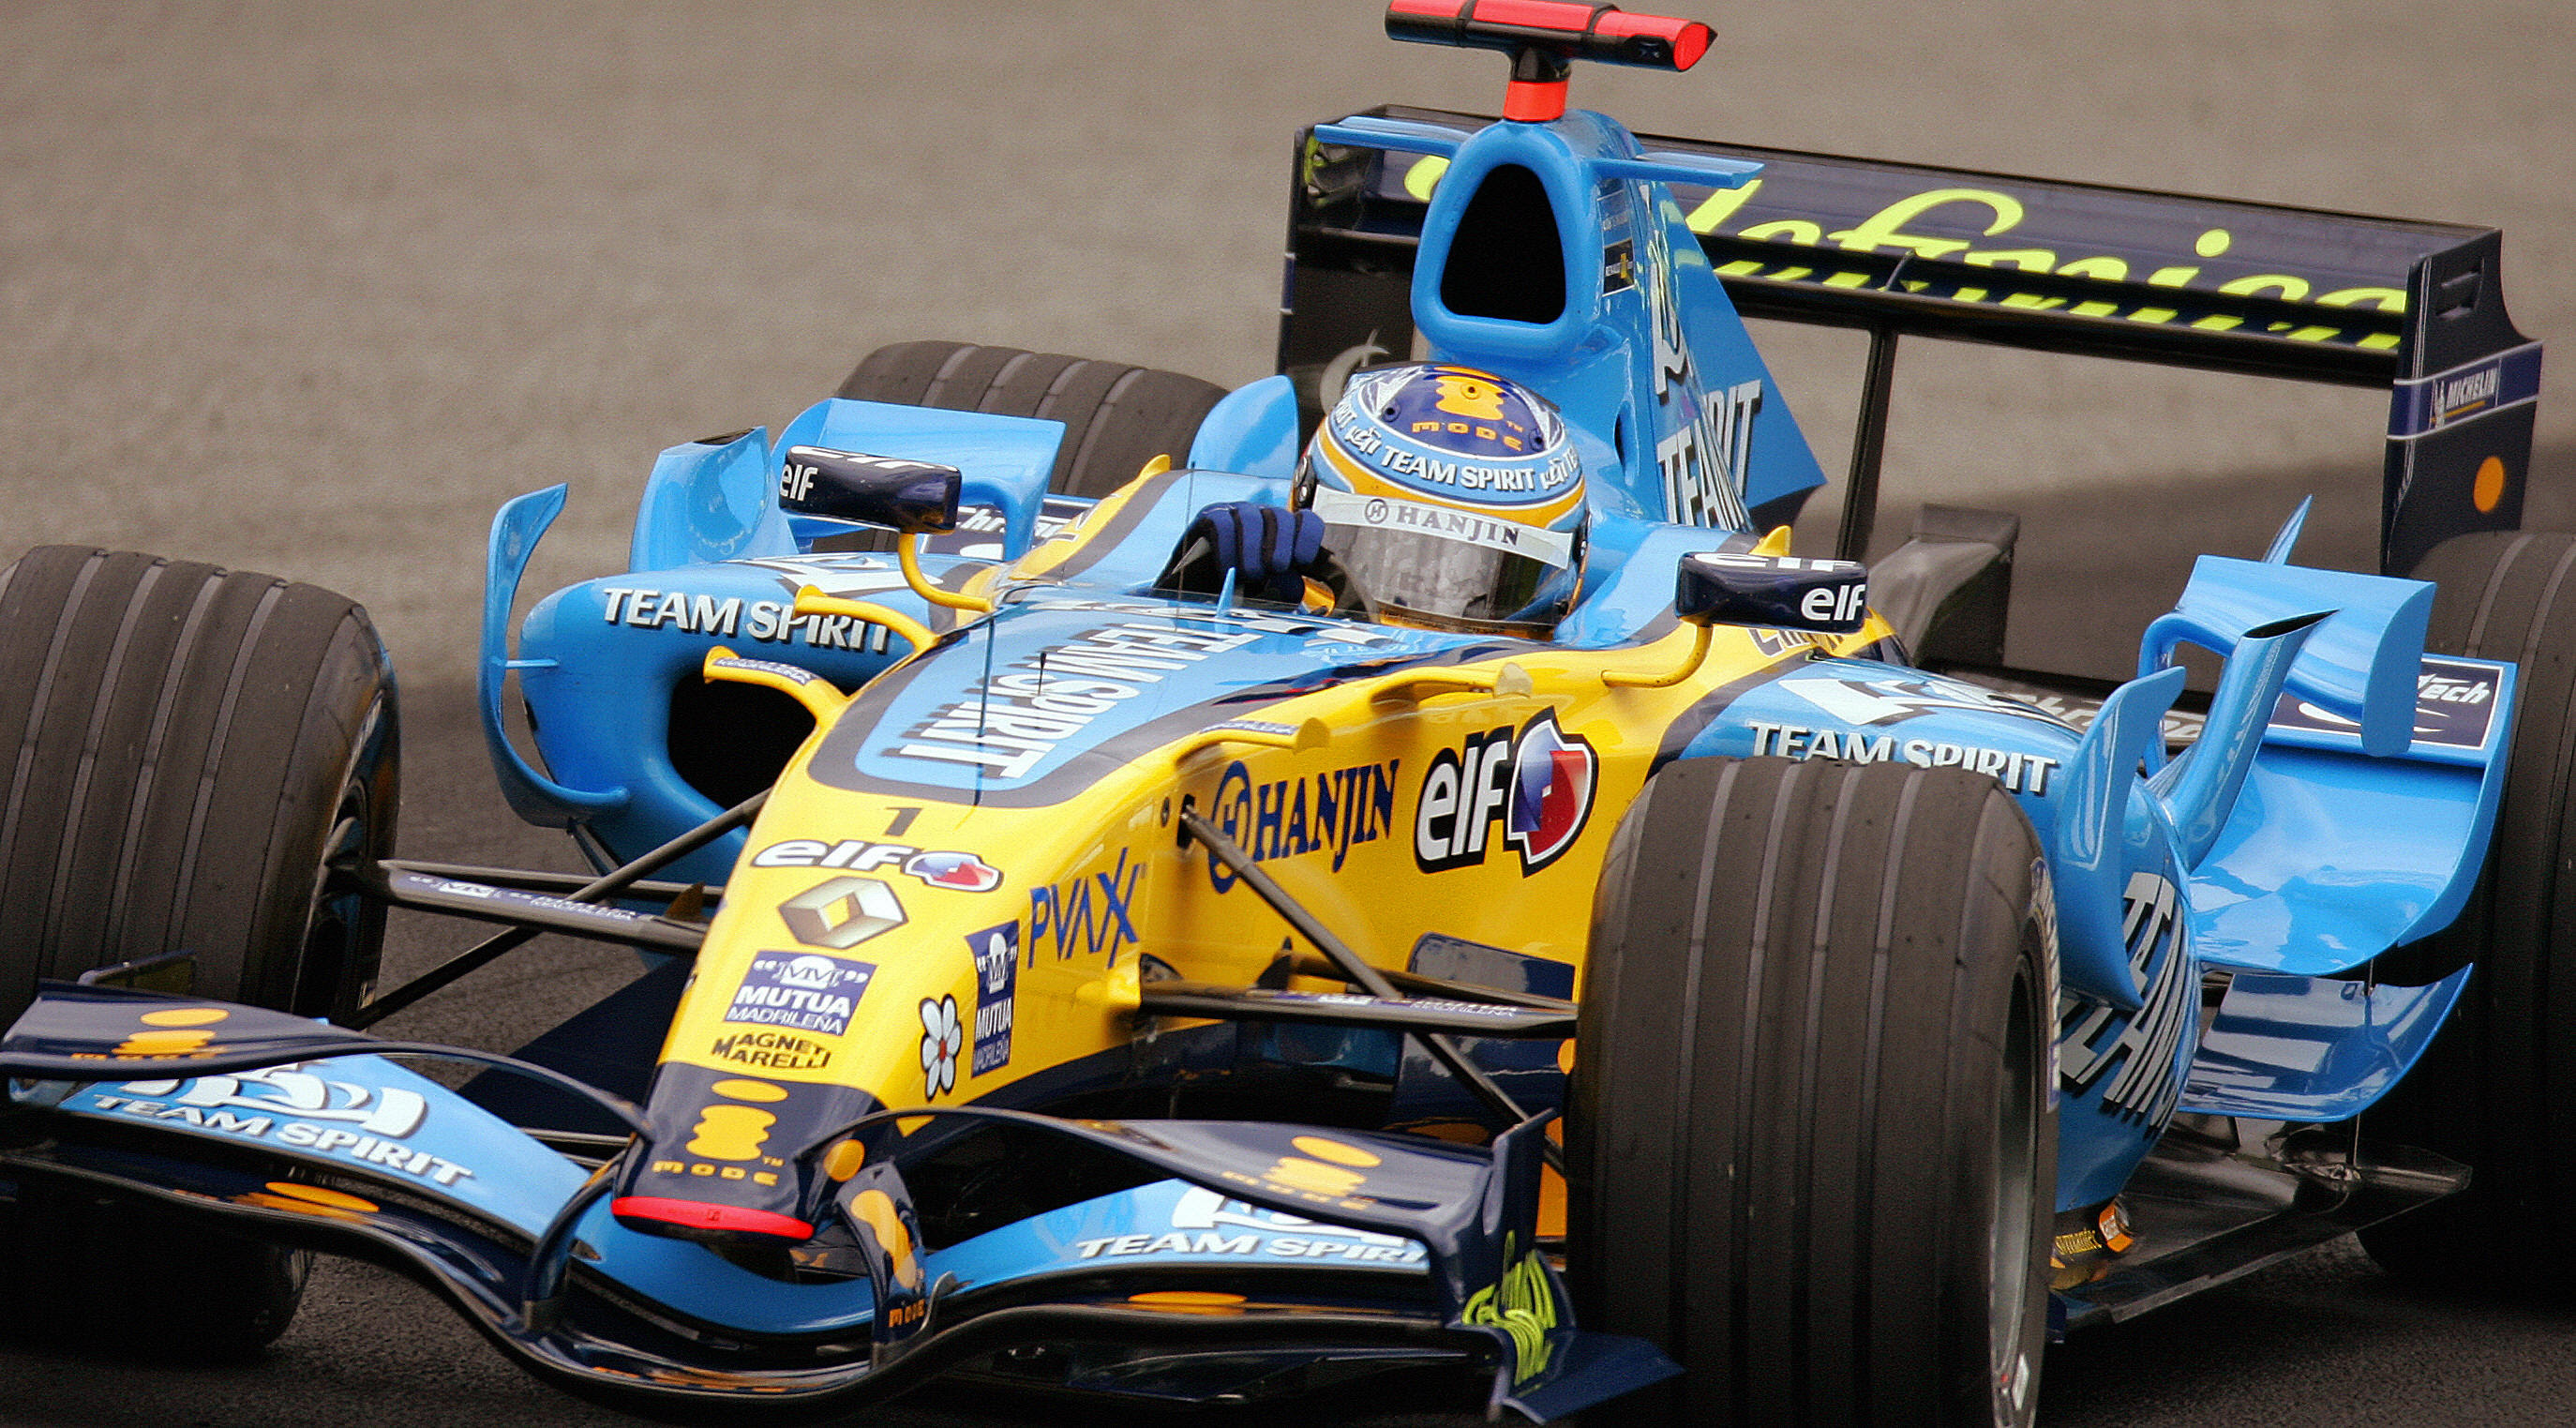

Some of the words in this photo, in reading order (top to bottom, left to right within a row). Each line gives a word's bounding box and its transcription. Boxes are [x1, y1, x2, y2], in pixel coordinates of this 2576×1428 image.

[2446, 368, 2499, 410] MICHELIN
[779, 463, 818, 502] elf
[1380, 444, 1455, 486] TEAM
[1460, 466, 1535, 491] SPIRIT
[1396, 507, 1520, 547] HANJIN
[603, 587, 741, 636] TEAM
[1800, 583, 1866, 622] elf
[1026, 622, 1264, 685] TEAM
[898, 672, 1142, 780] SPIRIT
[1750, 722, 1896, 763] TEAM
[1903, 739, 2058, 793] SPIRIT
[885, 806, 922, 836] 1
[1252, 759, 1400, 873] HANJIN
[1415, 746, 1508, 862] elf
[753, 840, 915, 872] elf
[734, 985, 851, 1018] MUTUA
[975, 997, 1012, 1043] MUTUA
[94, 1094, 273, 1136] TEAM
[276, 1120, 474, 1186] SPIRIT
[1075, 1233, 1261, 1259] TEAM
